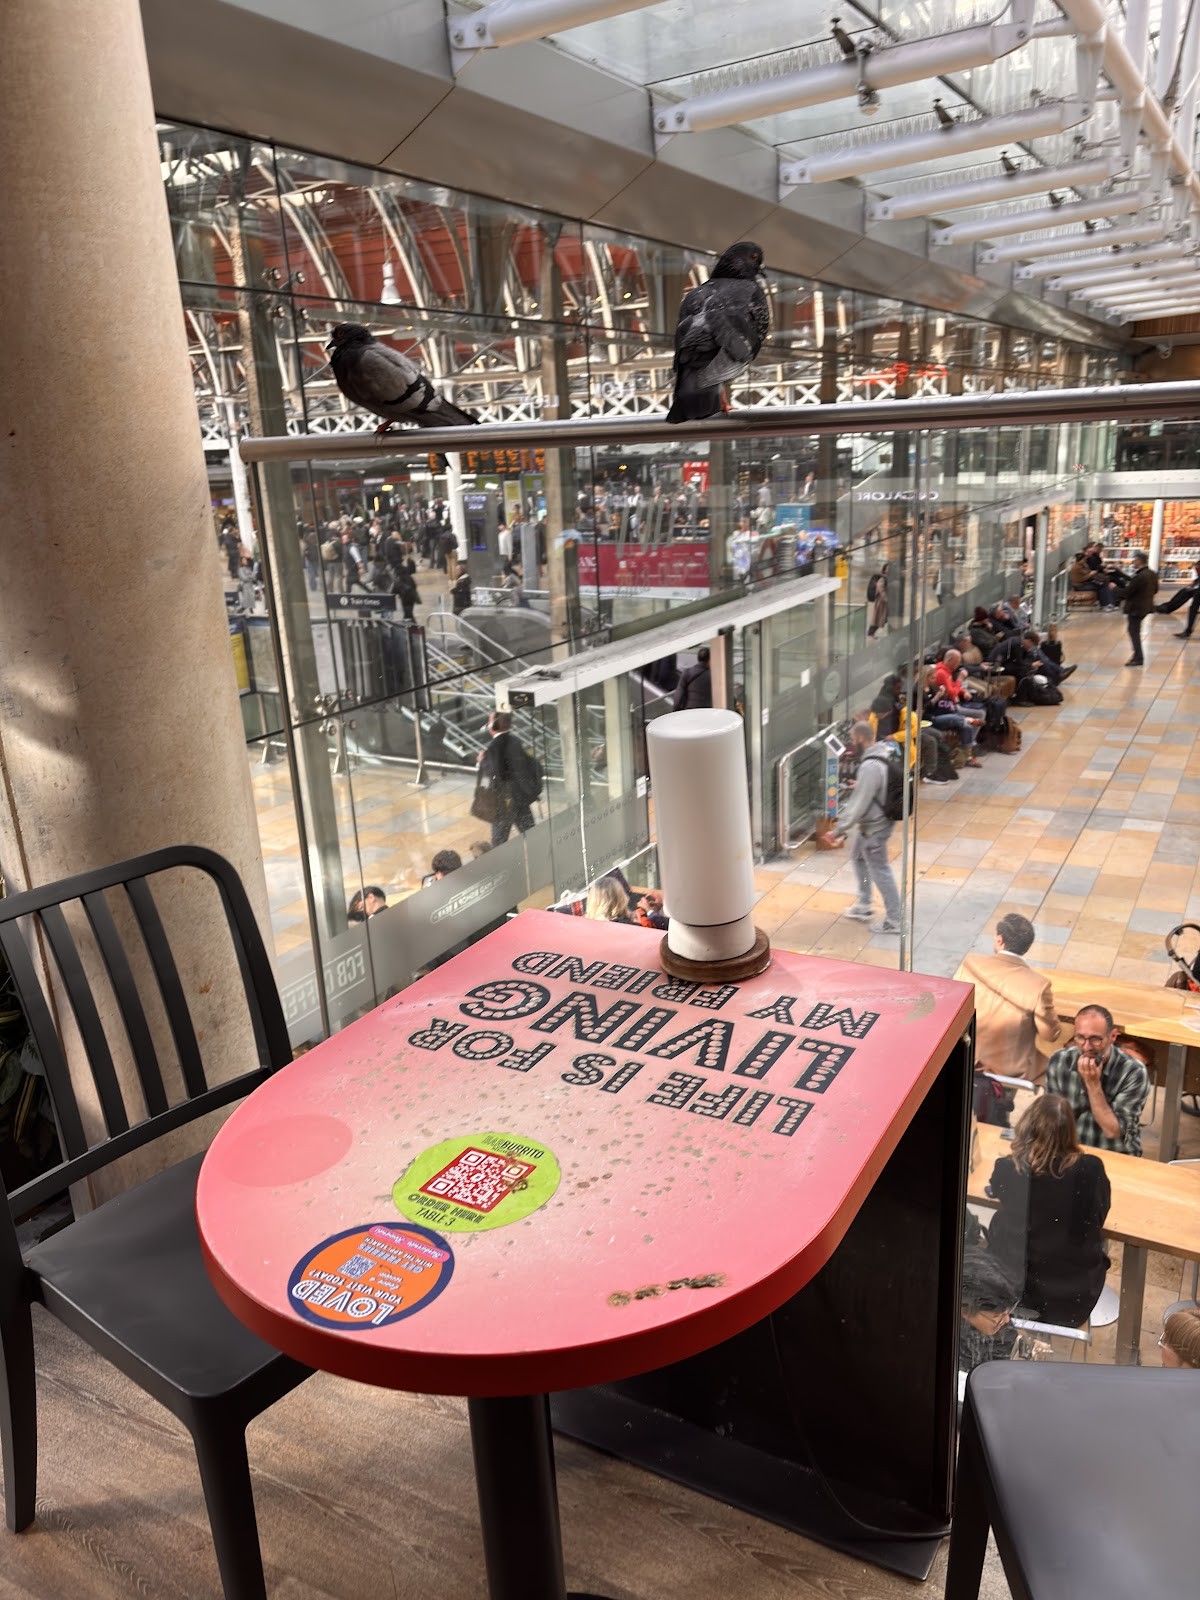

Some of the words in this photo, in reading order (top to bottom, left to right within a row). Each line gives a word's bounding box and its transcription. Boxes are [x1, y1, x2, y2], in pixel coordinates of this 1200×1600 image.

[512, 951, 741, 1011] FRIEND
[744, 995, 880, 1040] MY
[408, 1018, 557, 1073] FOR
[459, 979, 856, 1095] LIVING
[561, 1053, 645, 1095] IS
[645, 1070, 815, 1137] LIFE
[408, 1193, 451, 1213] ORDER
[450, 1207, 486, 1224] HERE
[416, 1207, 447, 1224] TABLE
[444, 1216, 456, 1227] 3
[364, 1237, 389, 1250] SEARCH
[308, 1269, 346, 1286] TODAY?
[415, 1257, 433, 1269] WITH
[291, 1279, 395, 1325] LOVED
[346, 1279, 374, 1295] VISIT
[374, 1288, 404, 1304] YOUR
